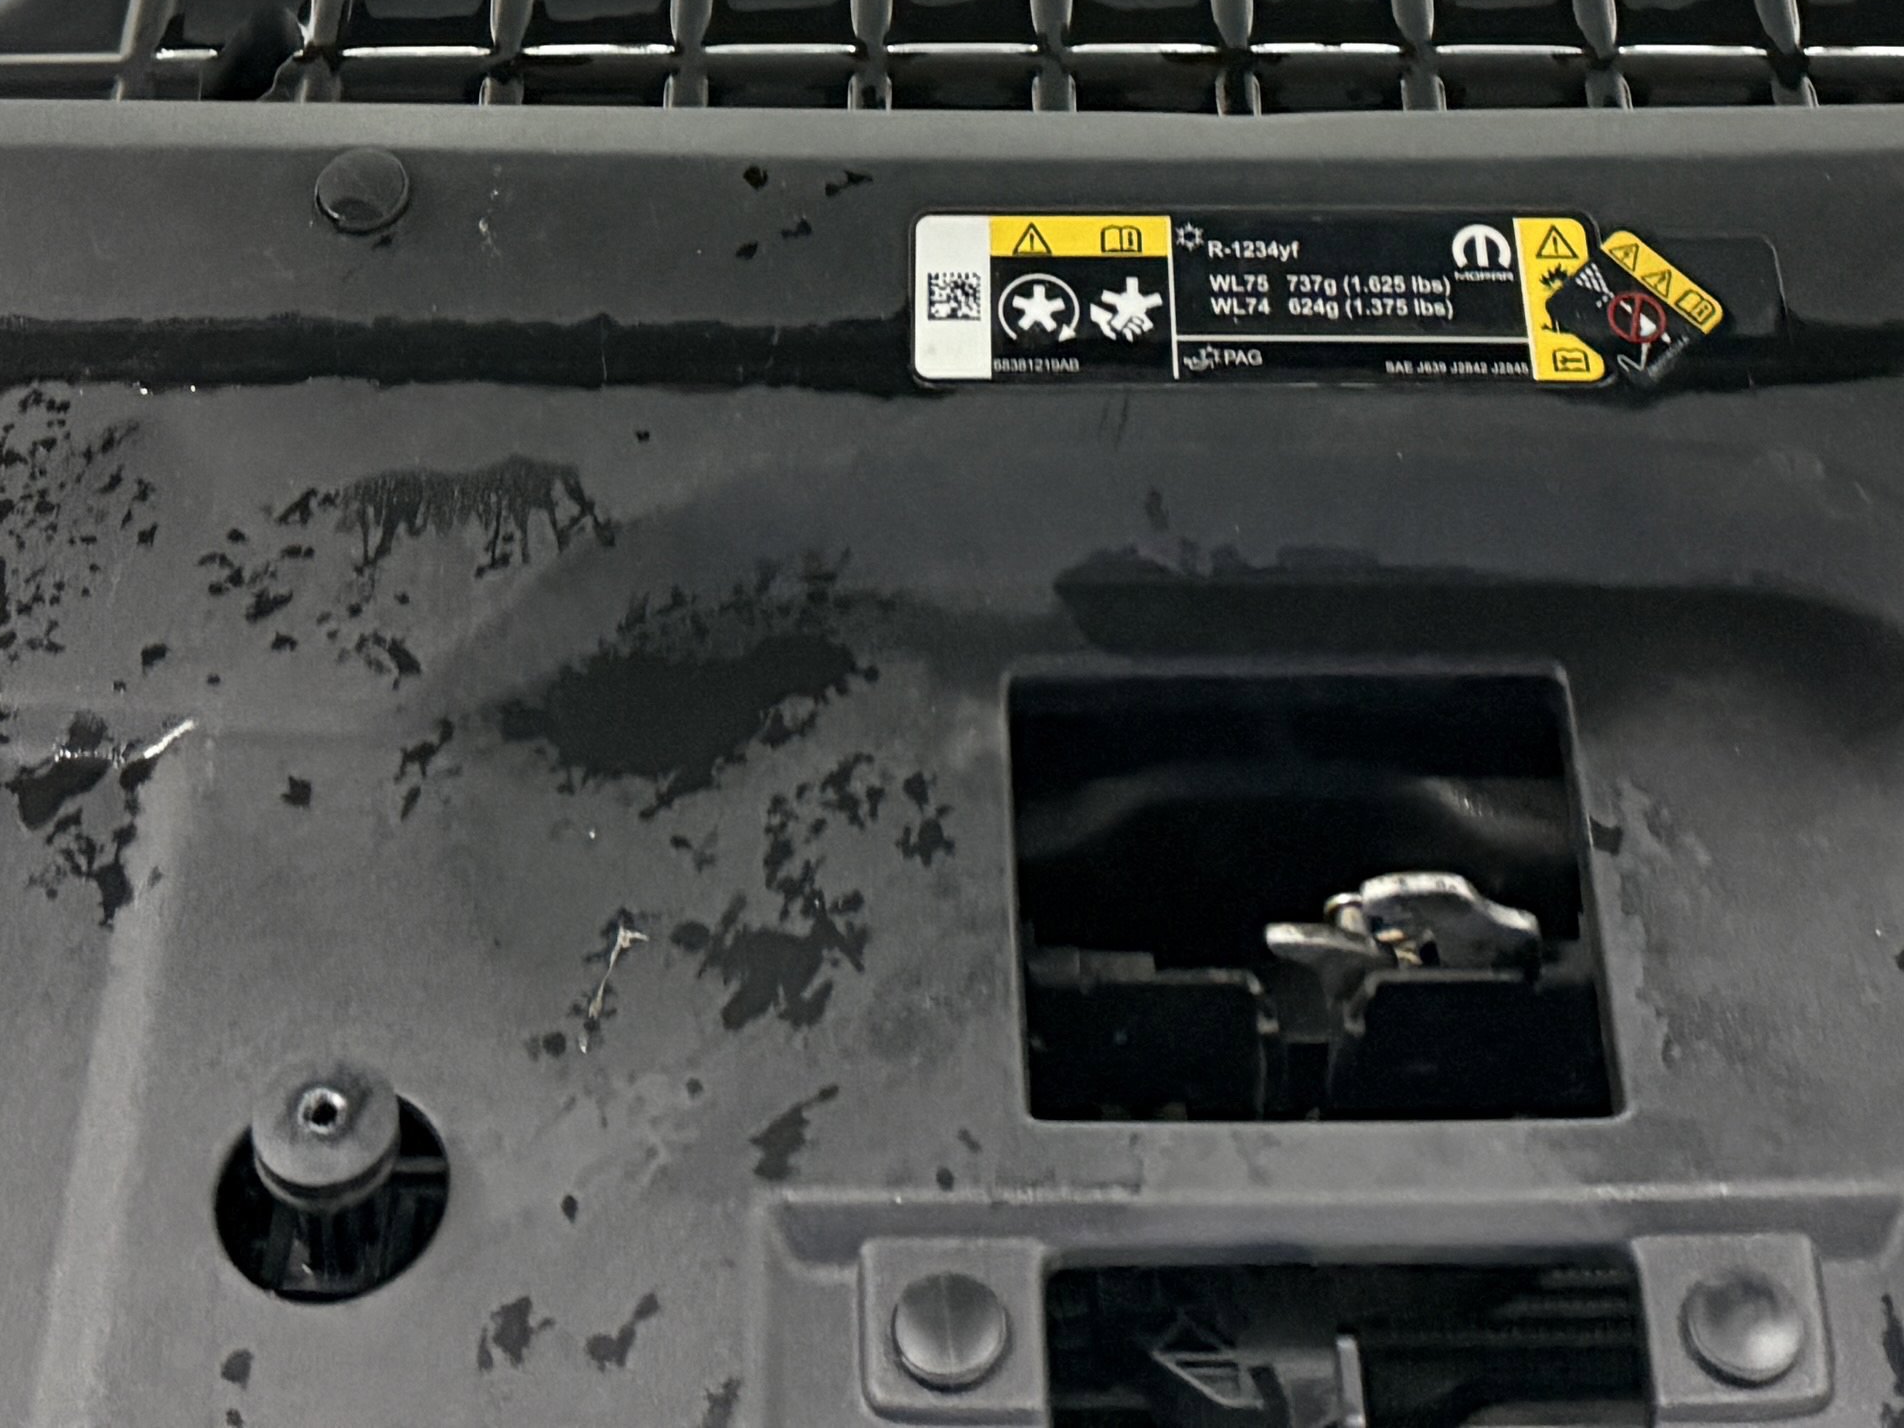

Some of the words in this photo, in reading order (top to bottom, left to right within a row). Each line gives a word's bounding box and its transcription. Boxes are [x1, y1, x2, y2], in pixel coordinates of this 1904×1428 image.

[1207, 240, 1300, 262] R-1234yf
[1209, 274, 1269, 293] WL75
[1286, 274, 1337, 296] 737g
[1343, 274, 1406, 296] (1.625
[1411, 274, 1451, 296] lbs)
[1211, 297, 1271, 316] WL74
[1288, 297, 1339, 319] 624g
[1345, 297, 1409, 319] (1.375
[1413, 297, 1454, 320] lbs)
[1223, 349, 1263, 366] PAG
